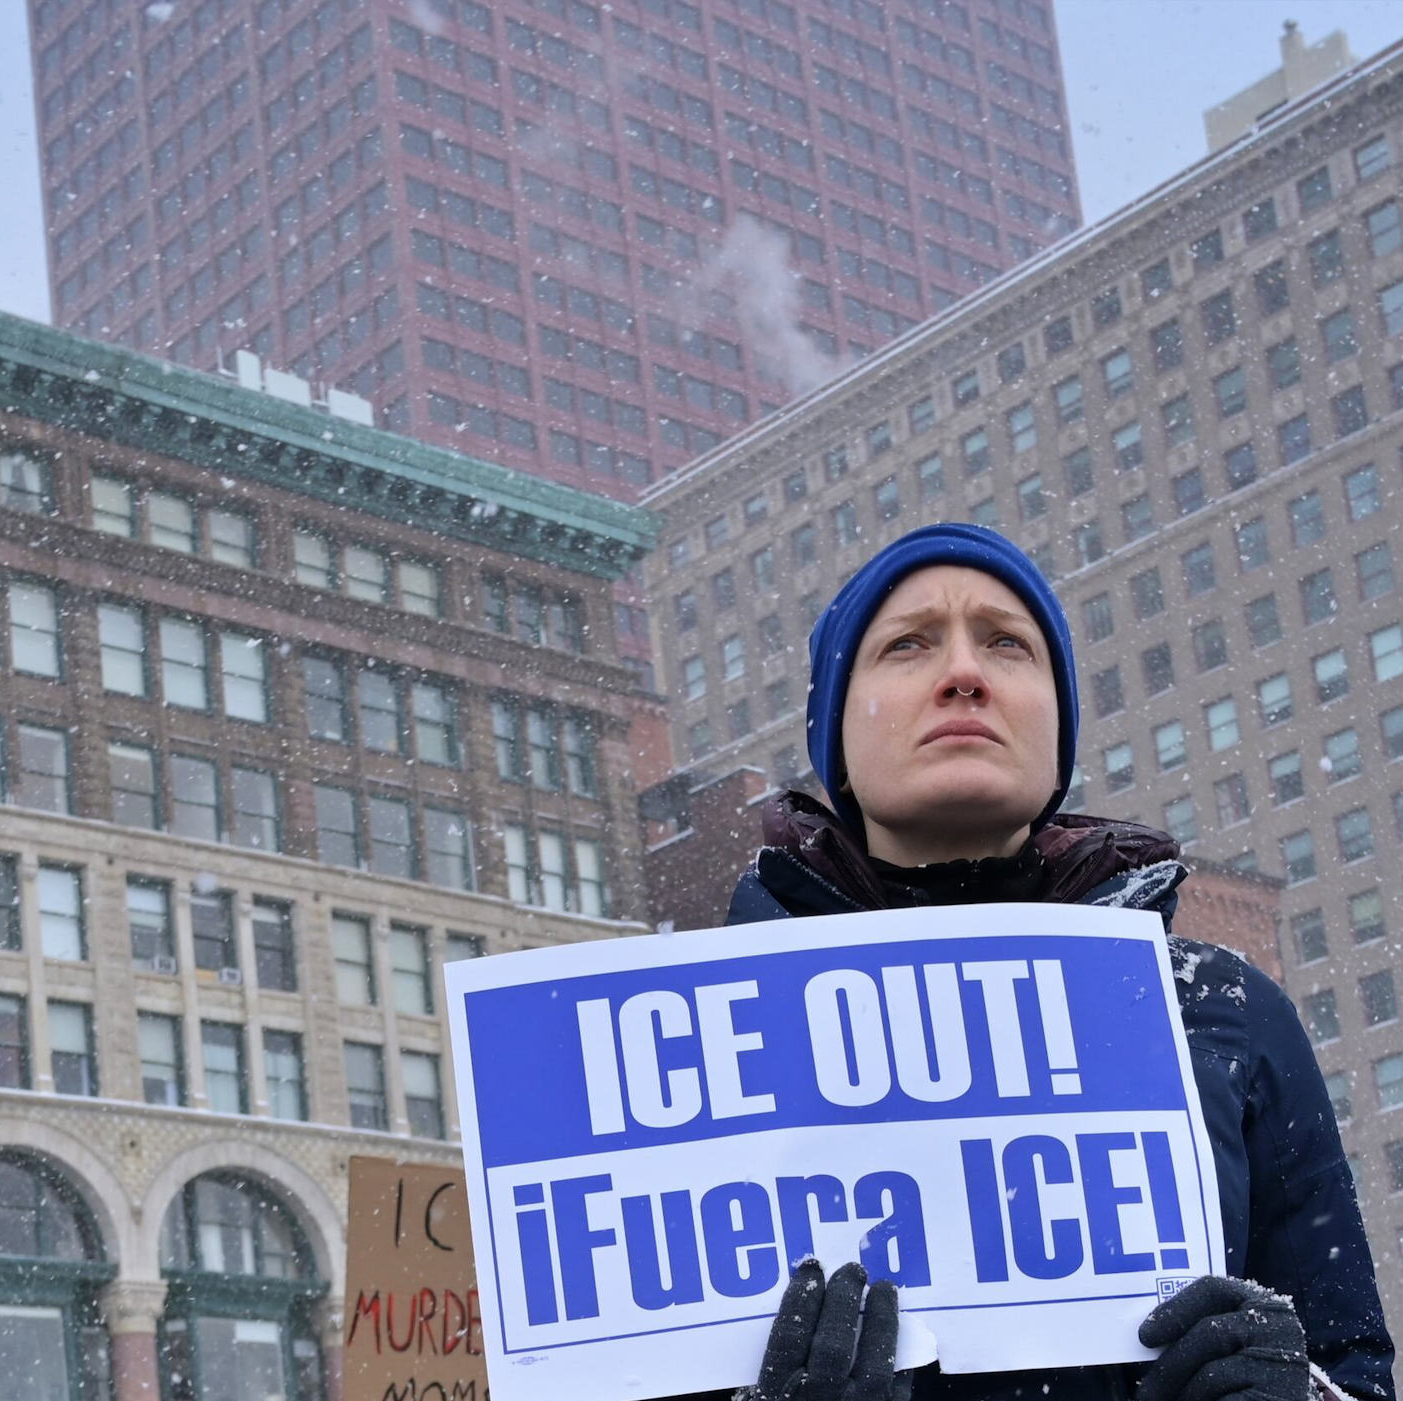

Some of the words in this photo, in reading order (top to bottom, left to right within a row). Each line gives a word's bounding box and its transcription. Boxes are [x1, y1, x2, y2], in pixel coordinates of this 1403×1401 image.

[577, 980, 776, 1136] ICE
[804, 958, 1082, 1107] OUT!
[960, 1130, 1190, 1284] ICE!
